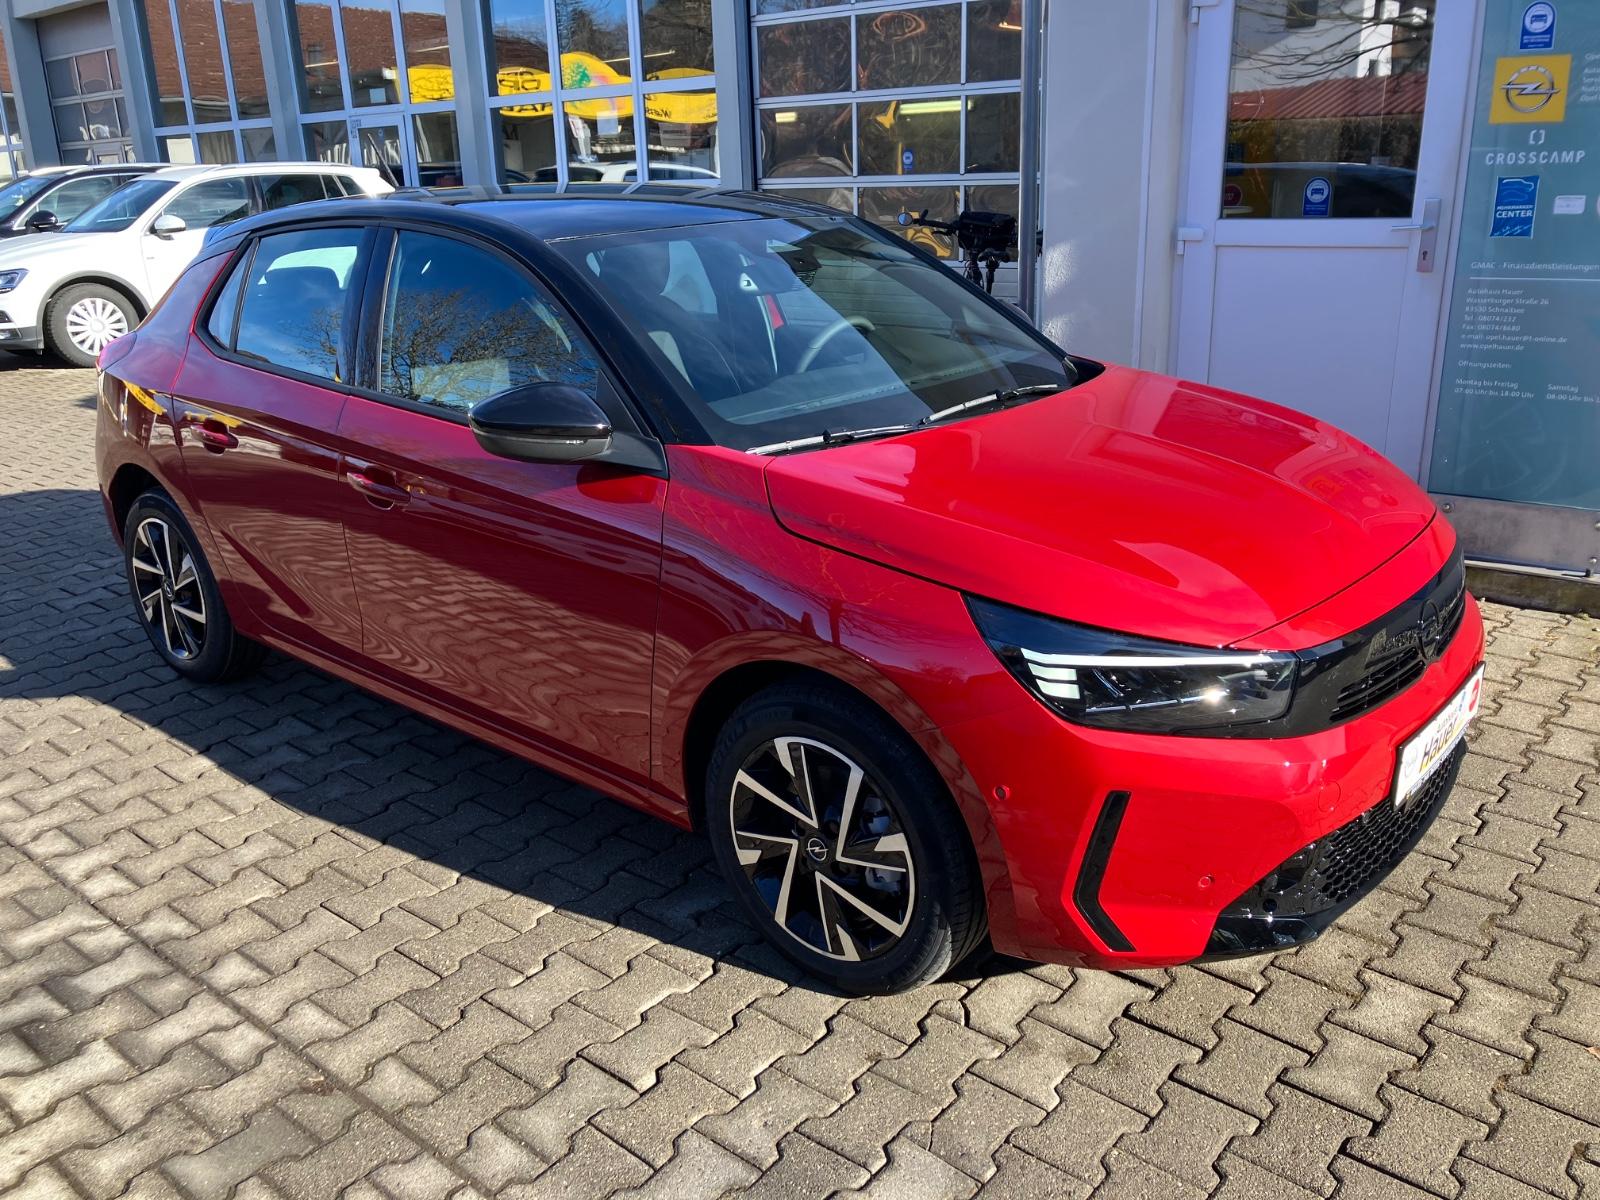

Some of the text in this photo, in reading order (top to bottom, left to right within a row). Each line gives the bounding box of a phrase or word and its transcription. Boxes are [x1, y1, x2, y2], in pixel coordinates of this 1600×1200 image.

[1485, 150, 1585, 165] CROSSCAMP
[1496, 210, 1533, 218] CENTER
[1456, 379, 1482, 387] Montag
[1494, 381, 1519, 389] Freitag
[1547, 383, 1579, 393] Samstag
